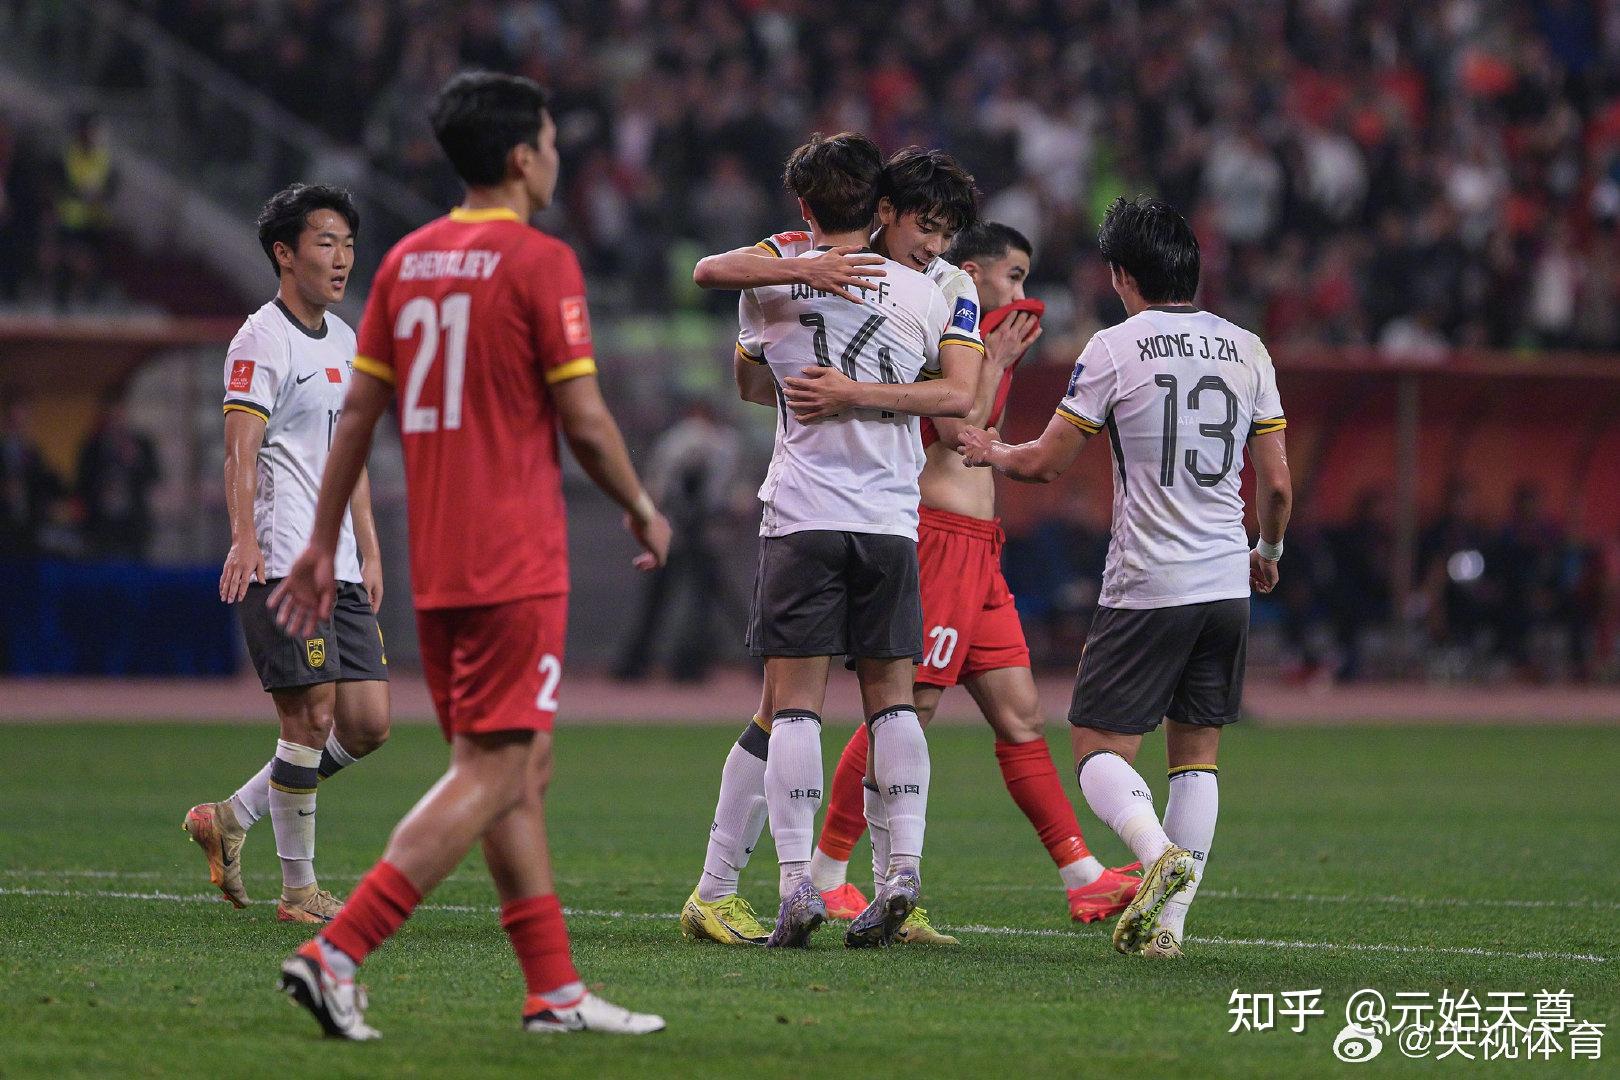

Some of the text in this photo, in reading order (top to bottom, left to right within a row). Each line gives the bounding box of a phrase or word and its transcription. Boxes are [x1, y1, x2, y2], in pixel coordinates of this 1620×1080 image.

[956, 308, 975, 320] AFC
[394, 292, 472, 433] 21
[1136, 333, 1244, 363] XIONG J.ZH.
[328, 409, 342, 452] 1
[1154, 373, 1238, 488] 13
[536, 653, 561, 711] 2
[790, 788, 821, 800] 中国
[888, 784, 920, 796] 中国
